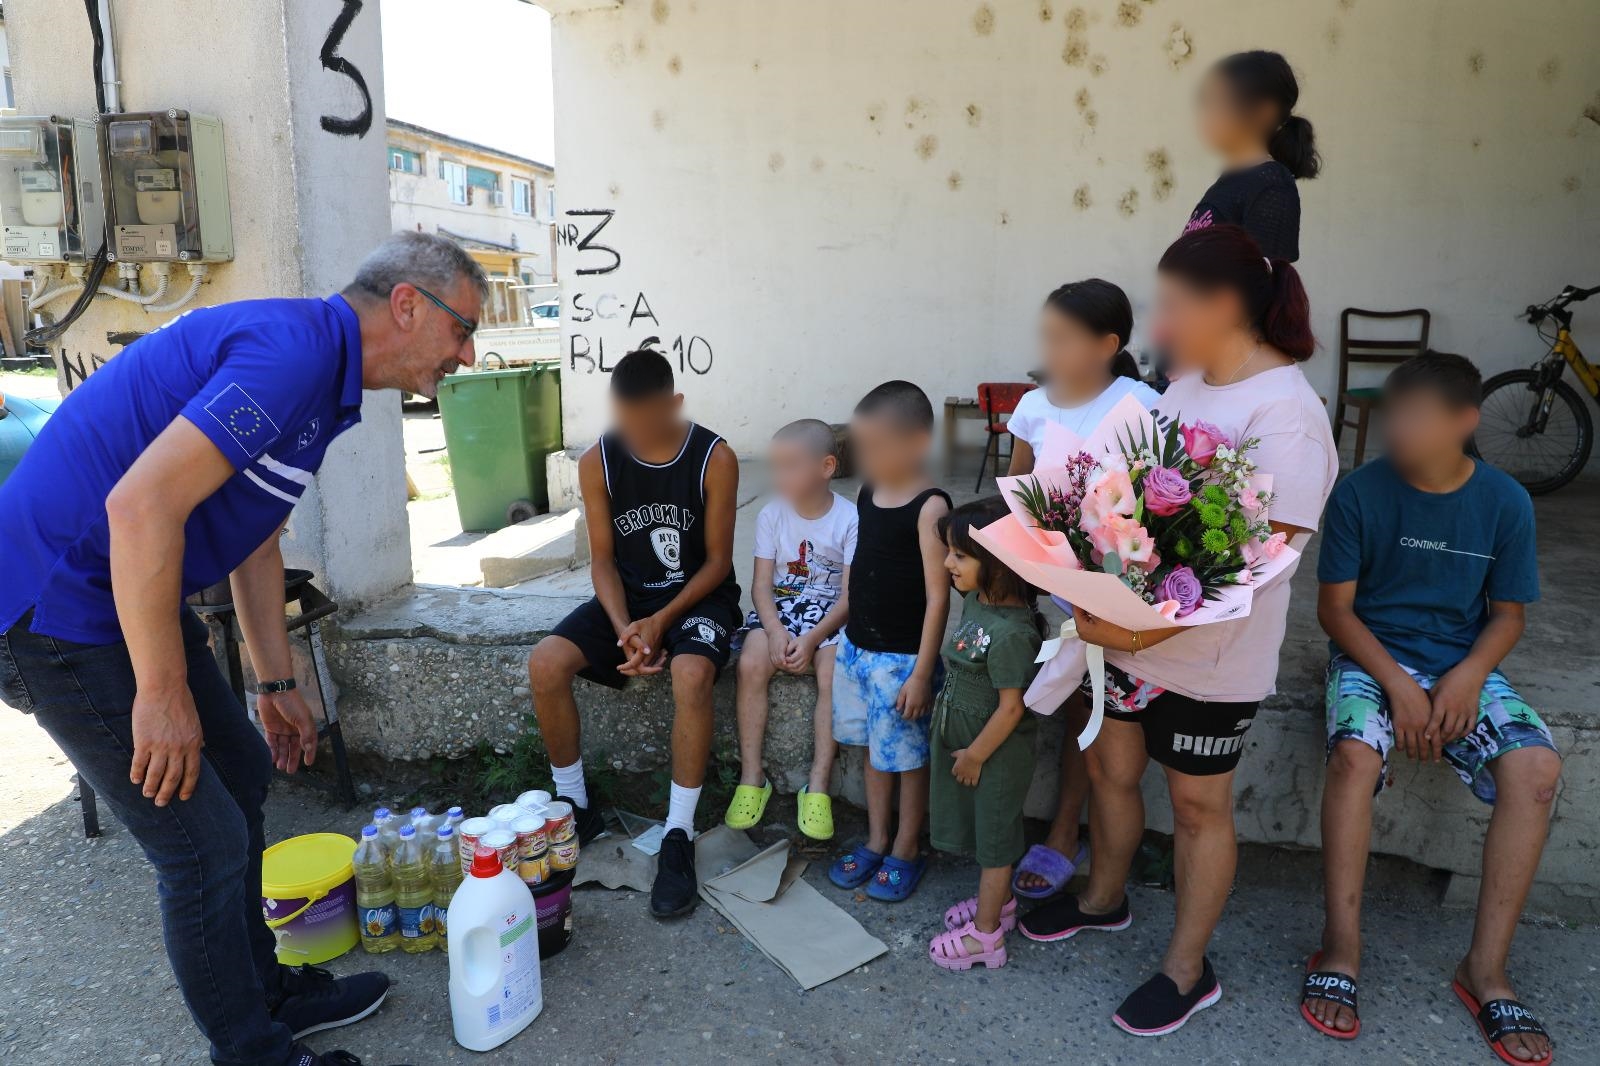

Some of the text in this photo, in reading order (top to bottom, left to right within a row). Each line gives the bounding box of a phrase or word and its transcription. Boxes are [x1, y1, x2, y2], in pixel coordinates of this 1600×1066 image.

[319, 0, 373, 140] 3
[557, 208, 621, 276] NR 3
[61, 348, 107, 391] N
[658, 533, 679, 544] NYC
[1399, 536, 1448, 551] CONTINUE
[1172, 732, 1246, 757] PUM
[1305, 973, 1357, 995] Super
